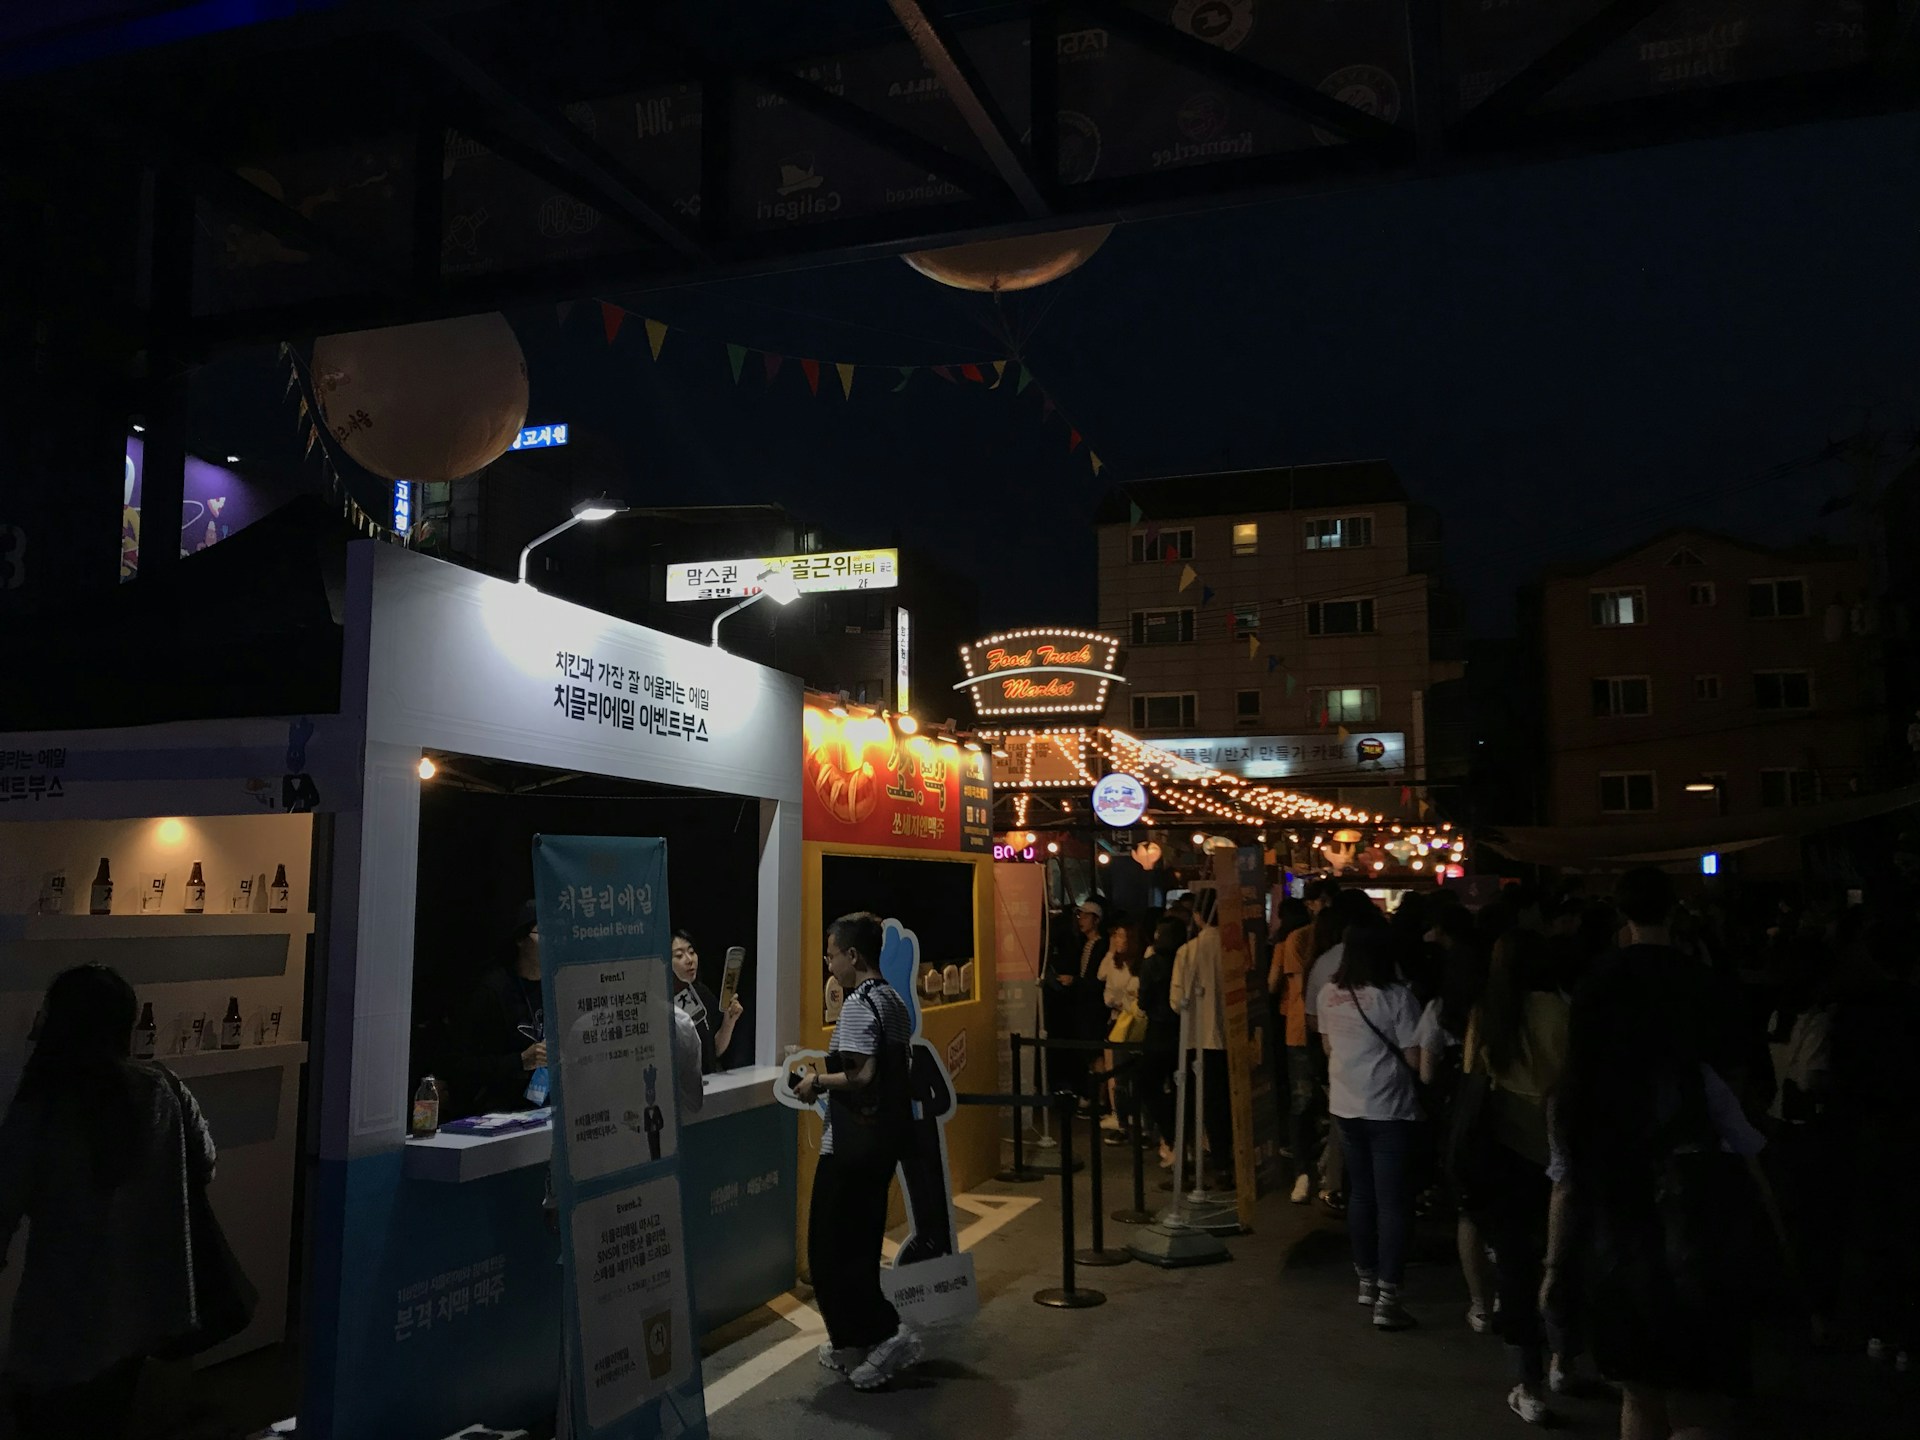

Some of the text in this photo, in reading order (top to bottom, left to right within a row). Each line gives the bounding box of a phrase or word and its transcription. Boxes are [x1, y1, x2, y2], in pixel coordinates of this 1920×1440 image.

[687, 565, 737, 586] 맘스퀸
[791, 556, 850, 580] 골근위
[986, 644, 1092, 671] Food Truck
[555, 651, 709, 711] 치킨과 가장 잘 어울리는 에일
[1003, 678, 1075, 698] Market
[554, 684, 709, 742] 치믈리에일 이벤트부스
[38, 748, 66, 768] 에일
[1260, 745, 1305, 761] 만들기
[558, 883, 652, 918] 치믈리에일
[572, 921, 645, 941] Special Event
[600, 971, 625, 983] Event.1
[577, 991, 647, 1012] 치믈리에 더부스맨과
[582, 1030, 598, 1044] 랜덤
[616, 1196, 642, 1214] Event.2
[601, 1214, 661, 1245] 치믈리에일 마시고
[597, 1227, 667, 1264] SNS에 인증샷 올리면
[593, 1263, 616, 1283] 스페셜
[394, 1272, 506, 1343] 본격 치맥 맥주
